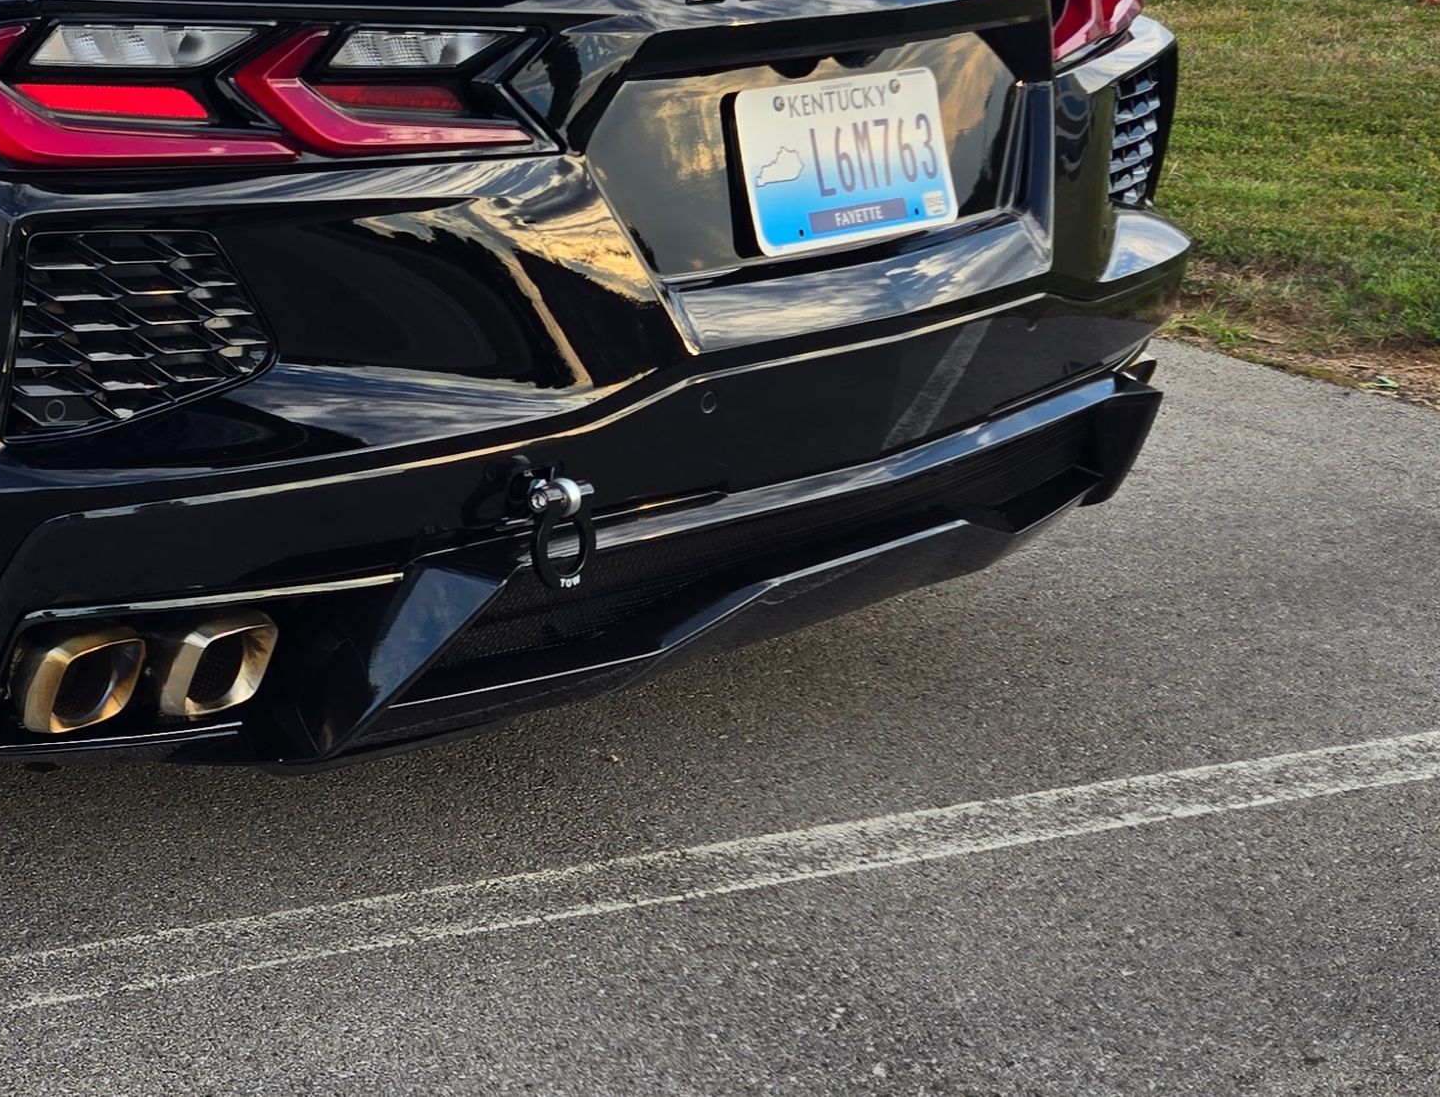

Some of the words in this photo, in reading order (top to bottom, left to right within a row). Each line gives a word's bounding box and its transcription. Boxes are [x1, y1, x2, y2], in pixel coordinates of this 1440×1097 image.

[787, 85, 888, 118] KENTUCKY
[809, 113, 939, 198] L6M763
[833, 205, 884, 228] FAYETTE
[559, 574, 580, 588] TOW
